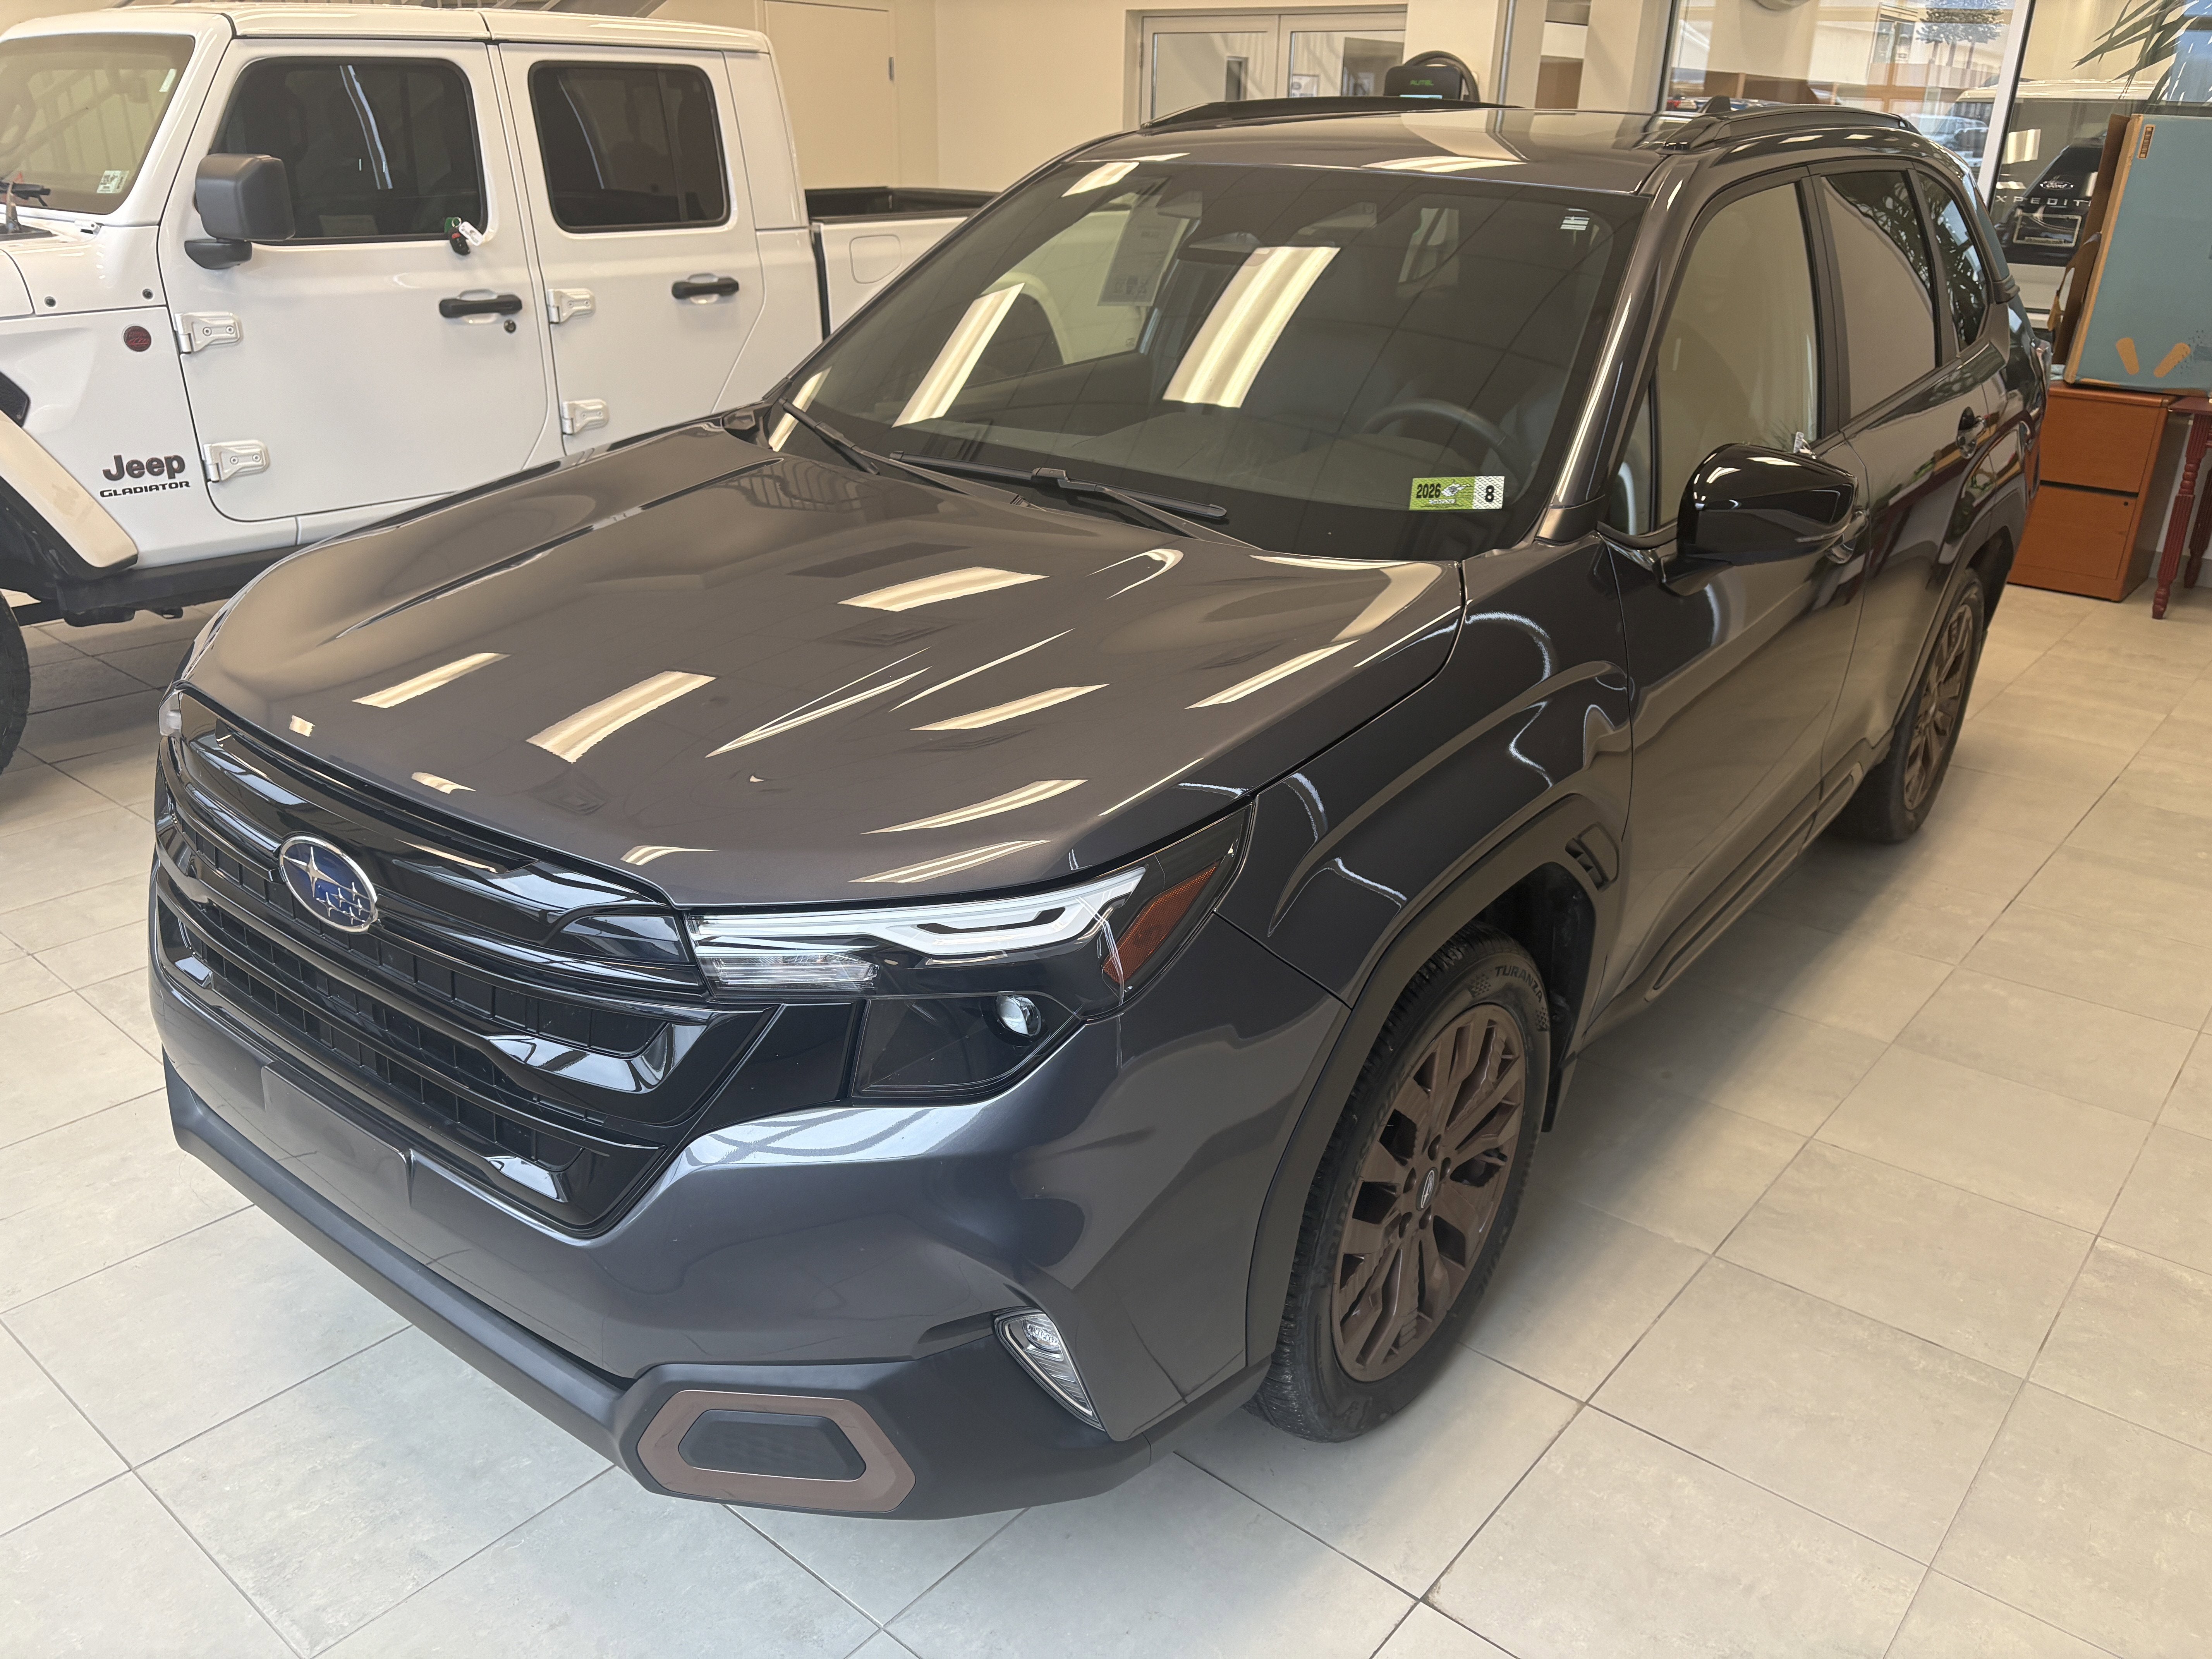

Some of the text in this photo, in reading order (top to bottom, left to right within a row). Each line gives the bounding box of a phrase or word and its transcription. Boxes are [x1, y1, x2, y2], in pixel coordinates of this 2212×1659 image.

[1995, 196, 2091, 207] XPEDITI
[103, 455, 185, 481] Jeep
[100, 481, 191, 497] GLADIATOR
[1416, 483, 1441, 498] 2026
[1485, 485, 1494, 502] 8
[1495, 965, 1542, 1003] TURANZA
